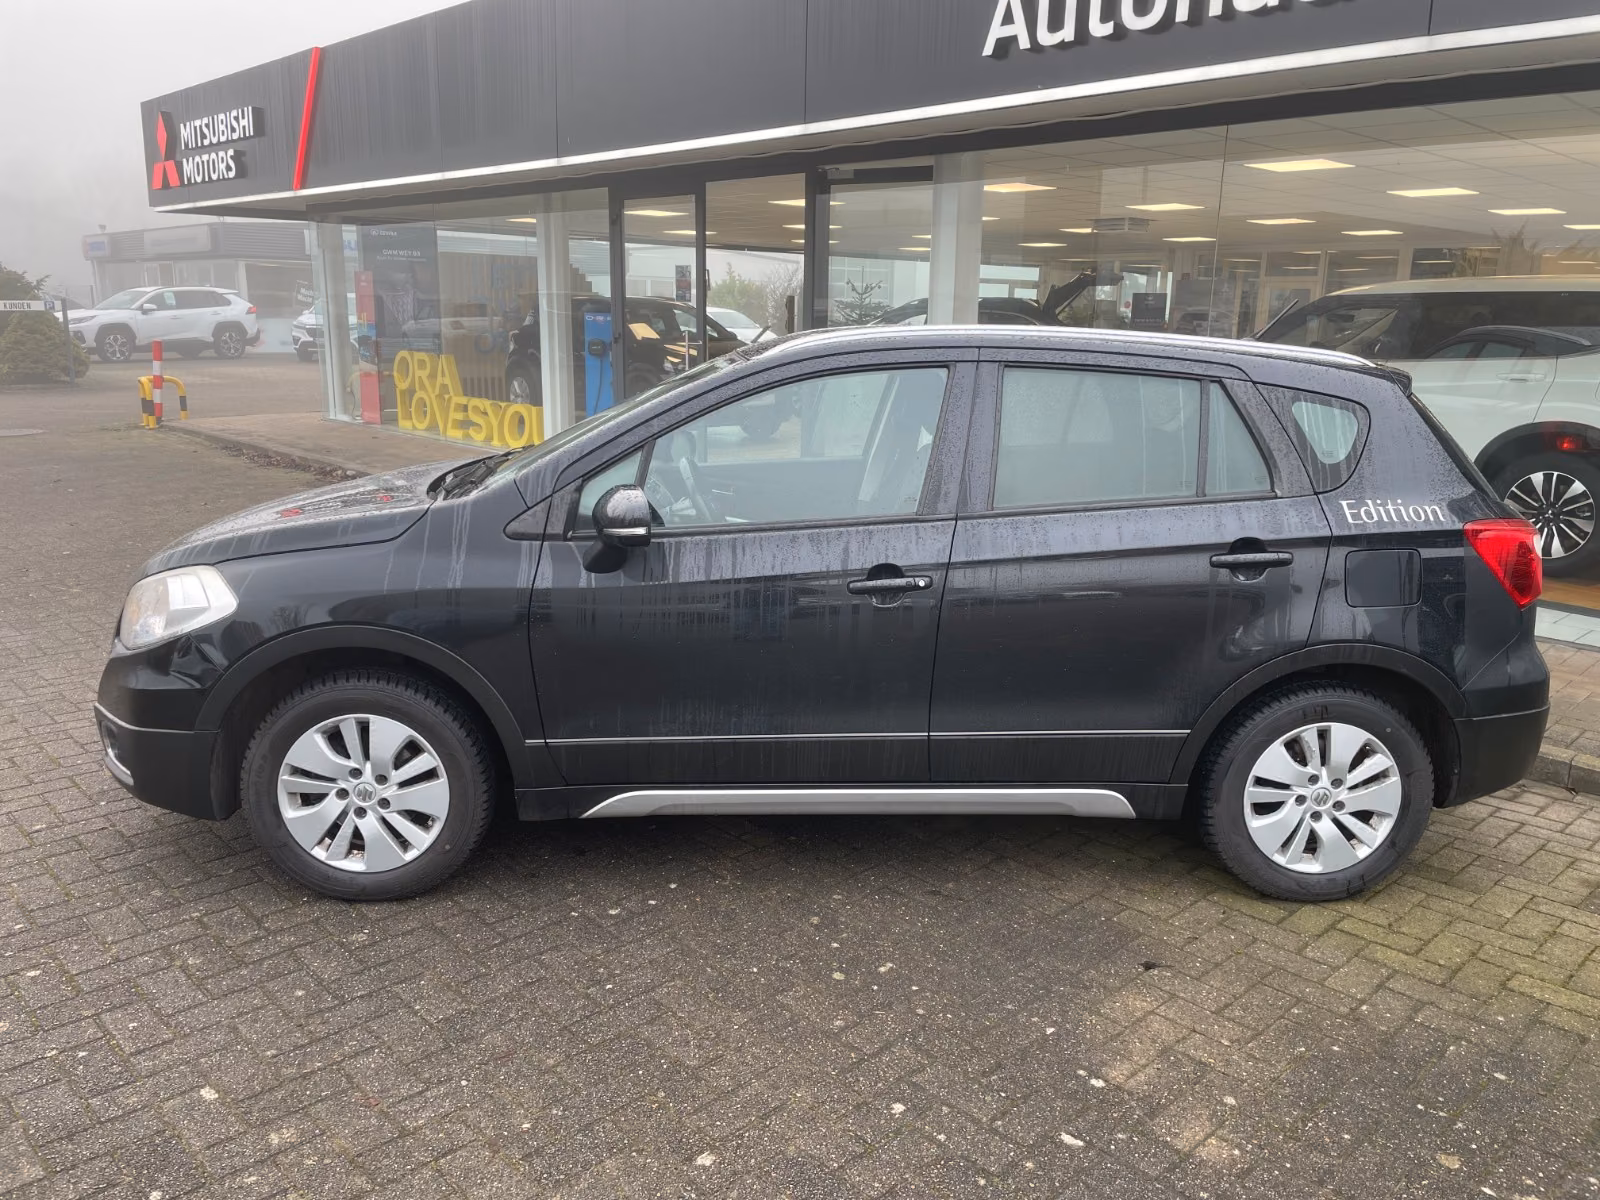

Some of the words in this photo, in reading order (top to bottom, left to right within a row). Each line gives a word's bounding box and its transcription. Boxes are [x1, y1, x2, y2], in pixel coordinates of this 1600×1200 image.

[982, 0, 1313, 57] Auto
[180, 106, 254, 150] MITSUBISHI
[182, 148, 236, 185] MOTORS
[3, 302, 32, 310] KUNDEN
[394, 350, 465, 396] ORA
[1338, 499, 1446, 525] Edition
